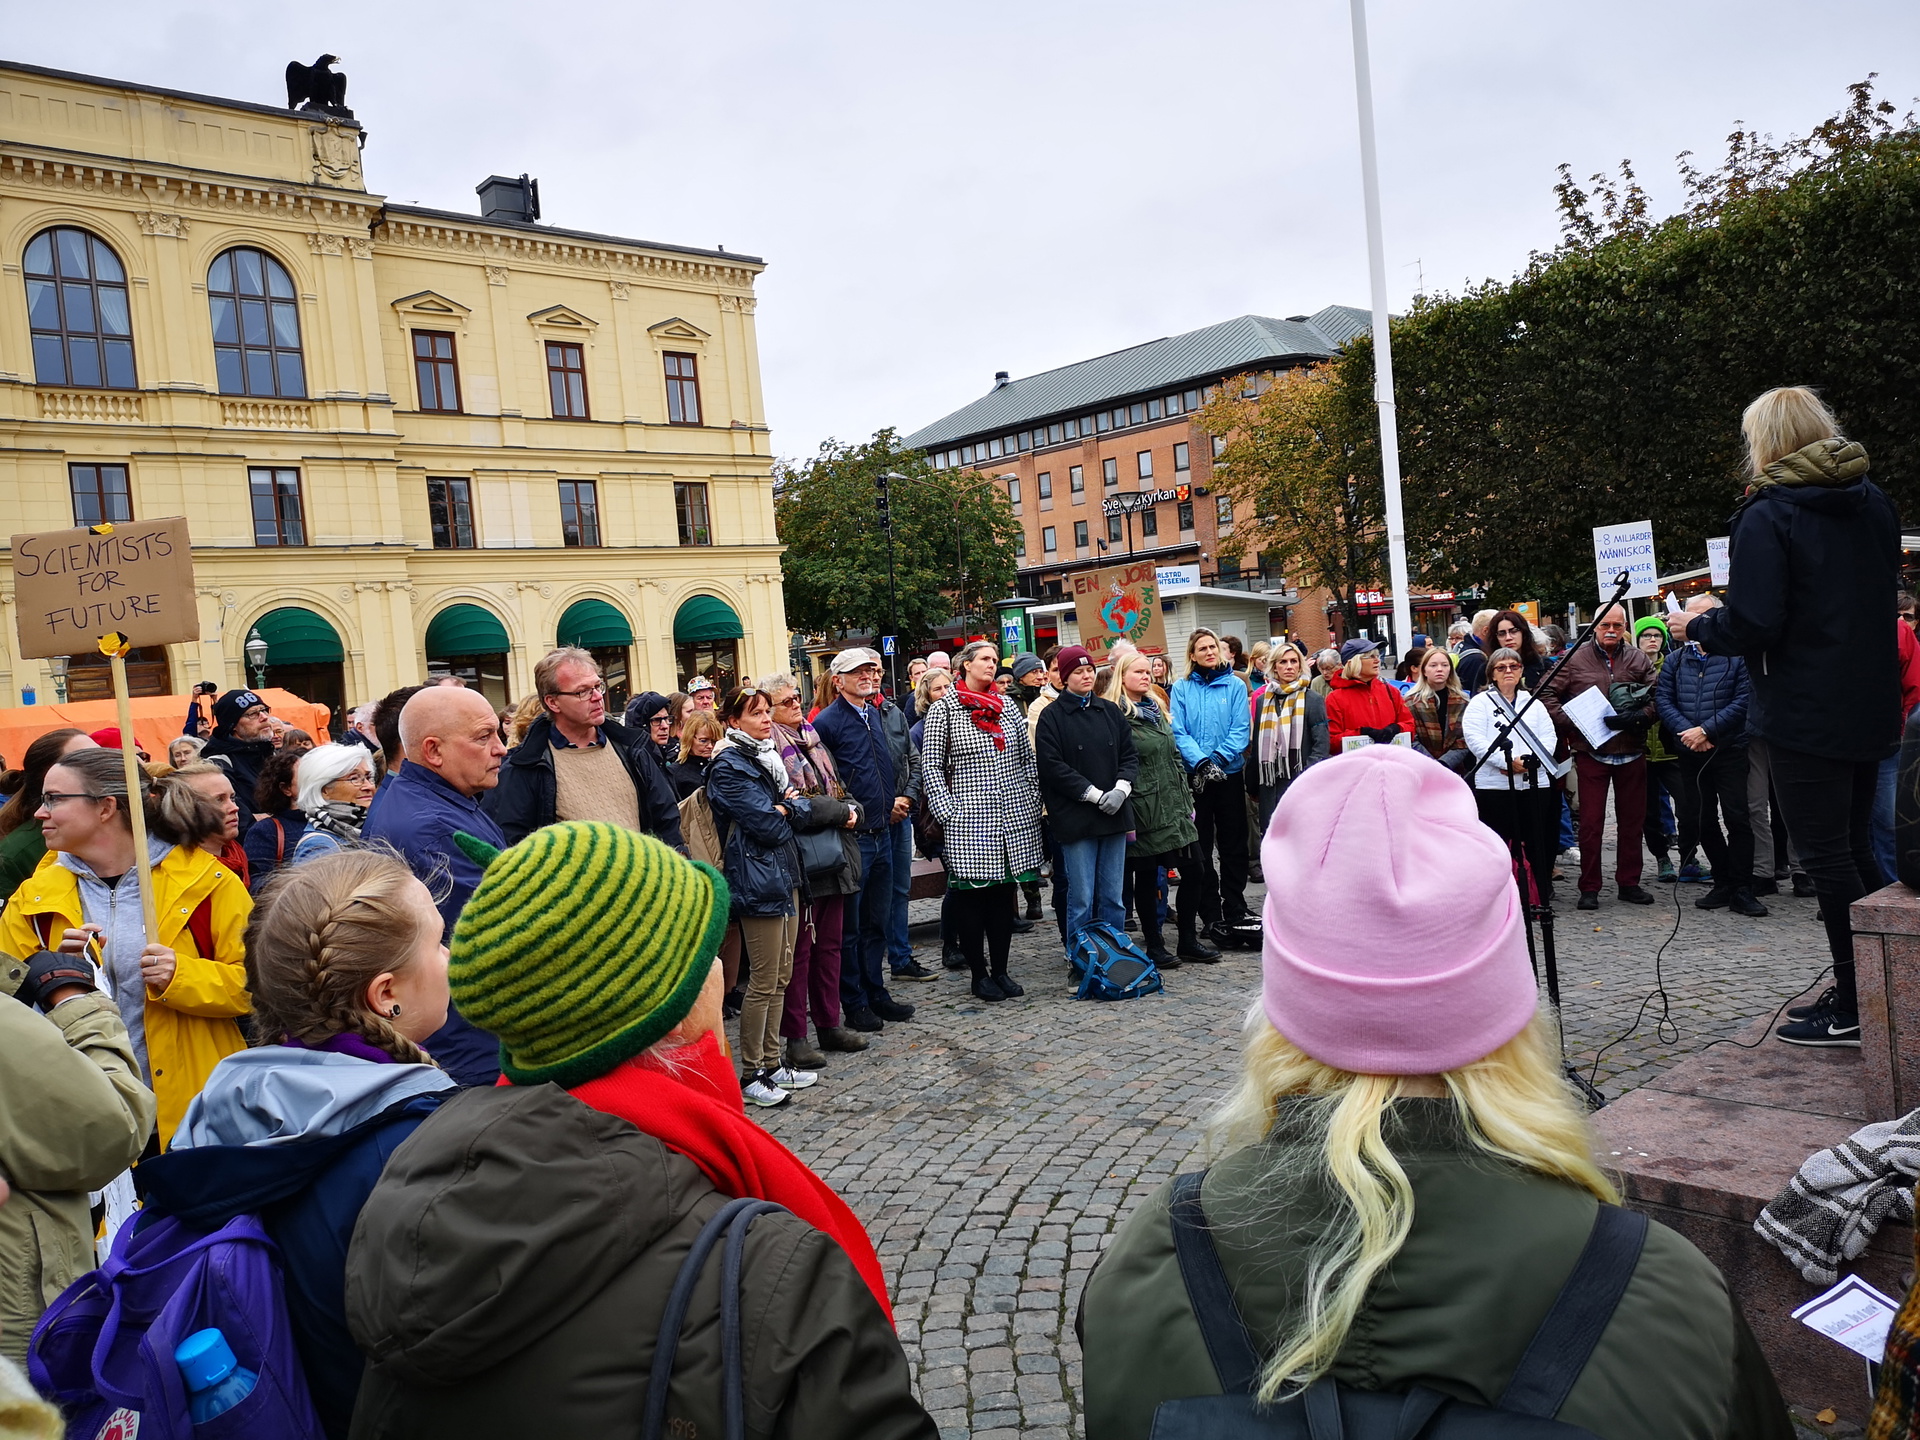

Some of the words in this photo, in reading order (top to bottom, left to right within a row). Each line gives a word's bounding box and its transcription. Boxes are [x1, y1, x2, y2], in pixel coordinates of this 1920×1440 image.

[1102, 498, 1141, 511] Svea
[1141, 488, 1176, 506] kyrkan
[1614, 531, 1652, 543] MILJARDER
[18, 532, 172, 576] SCIENTISTS
[1598, 544, 1652, 560] MÄNNISKOR
[78, 571, 125, 595] FOR
[1074, 574, 1100, 595] EN
[1157, 571, 1182, 579] RLSTAD
[1157, 577, 1190, 585] HTSEEING
[1601, 581, 1615, 589] OCH
[1633, 576, 1653, 585] ÖVER
[45, 594, 160, 634] FUTURE
[1085, 635, 1104, 652] ATT
[1130, 607, 1152, 643] RÄDD
